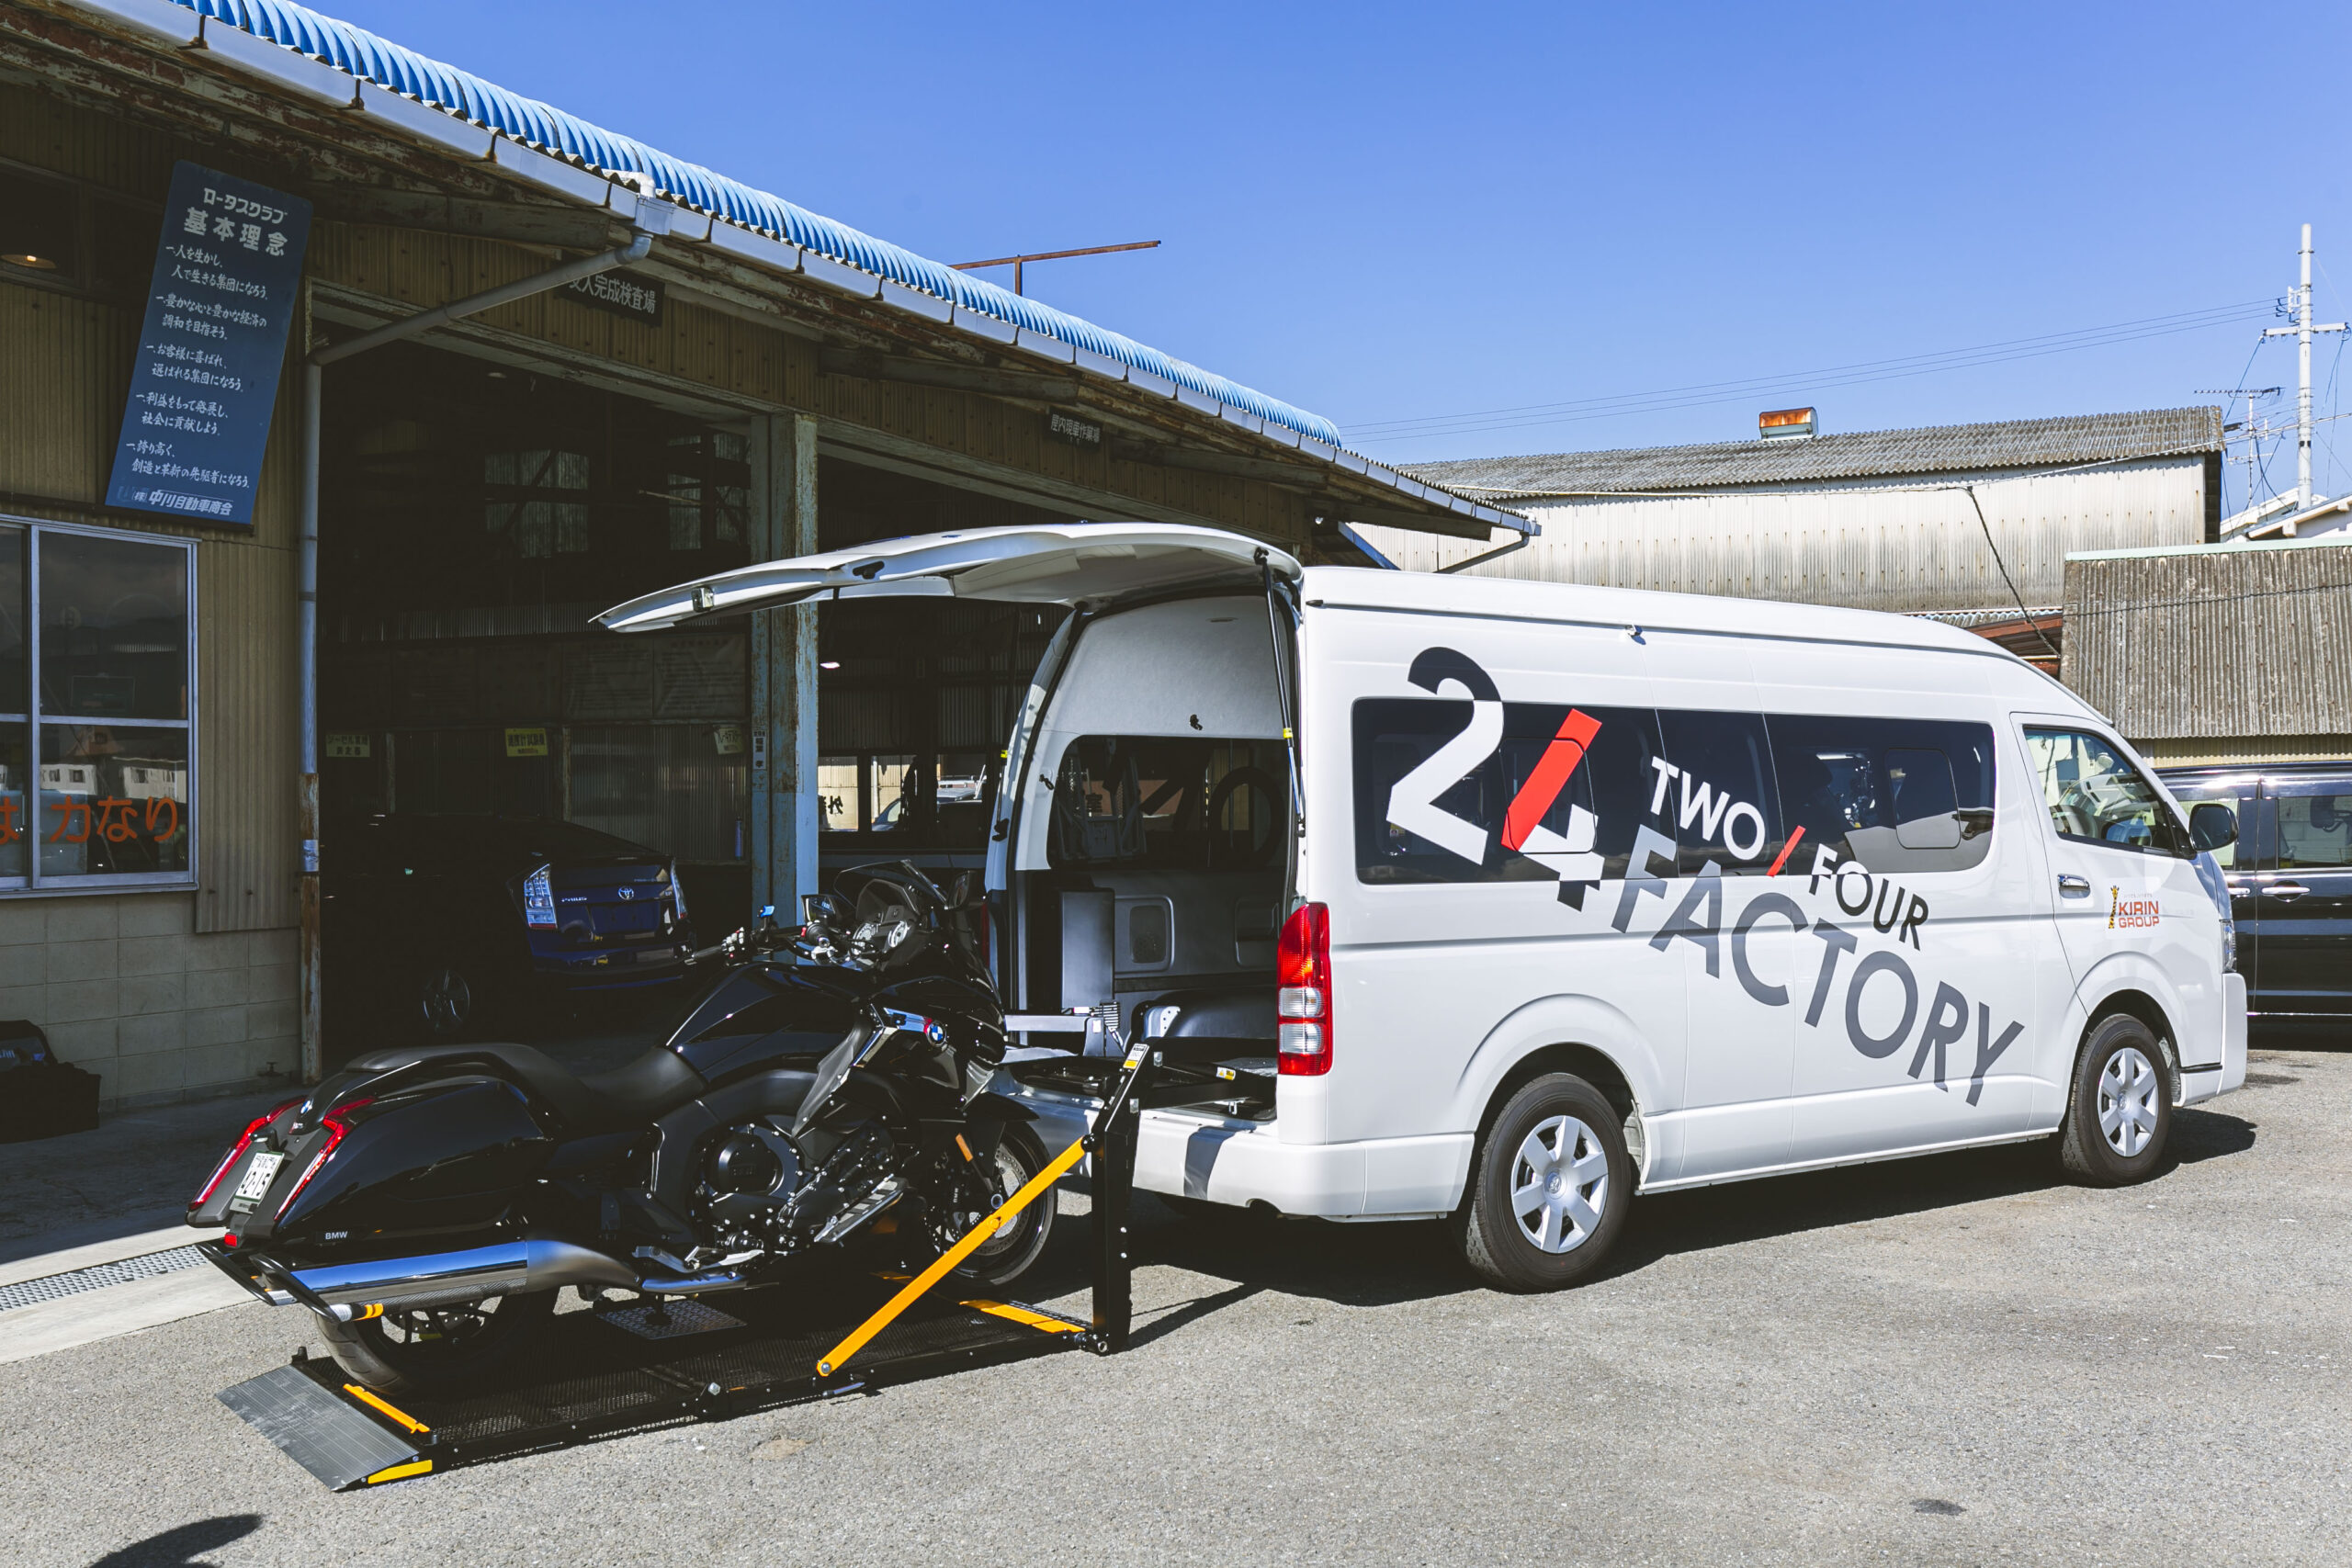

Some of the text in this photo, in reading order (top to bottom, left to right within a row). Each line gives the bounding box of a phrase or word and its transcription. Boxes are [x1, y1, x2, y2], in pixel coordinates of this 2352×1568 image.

[203, 187, 288, 224] ロータスクラブ
[184, 206, 288, 256] 基本理念
[2118, 900, 2159, 916] KIRIN
[2118, 916, 2160, 929] GROUP
[1611, 823, 2025, 1107] FACTORY
[325, 1231, 347, 1240] BMW
